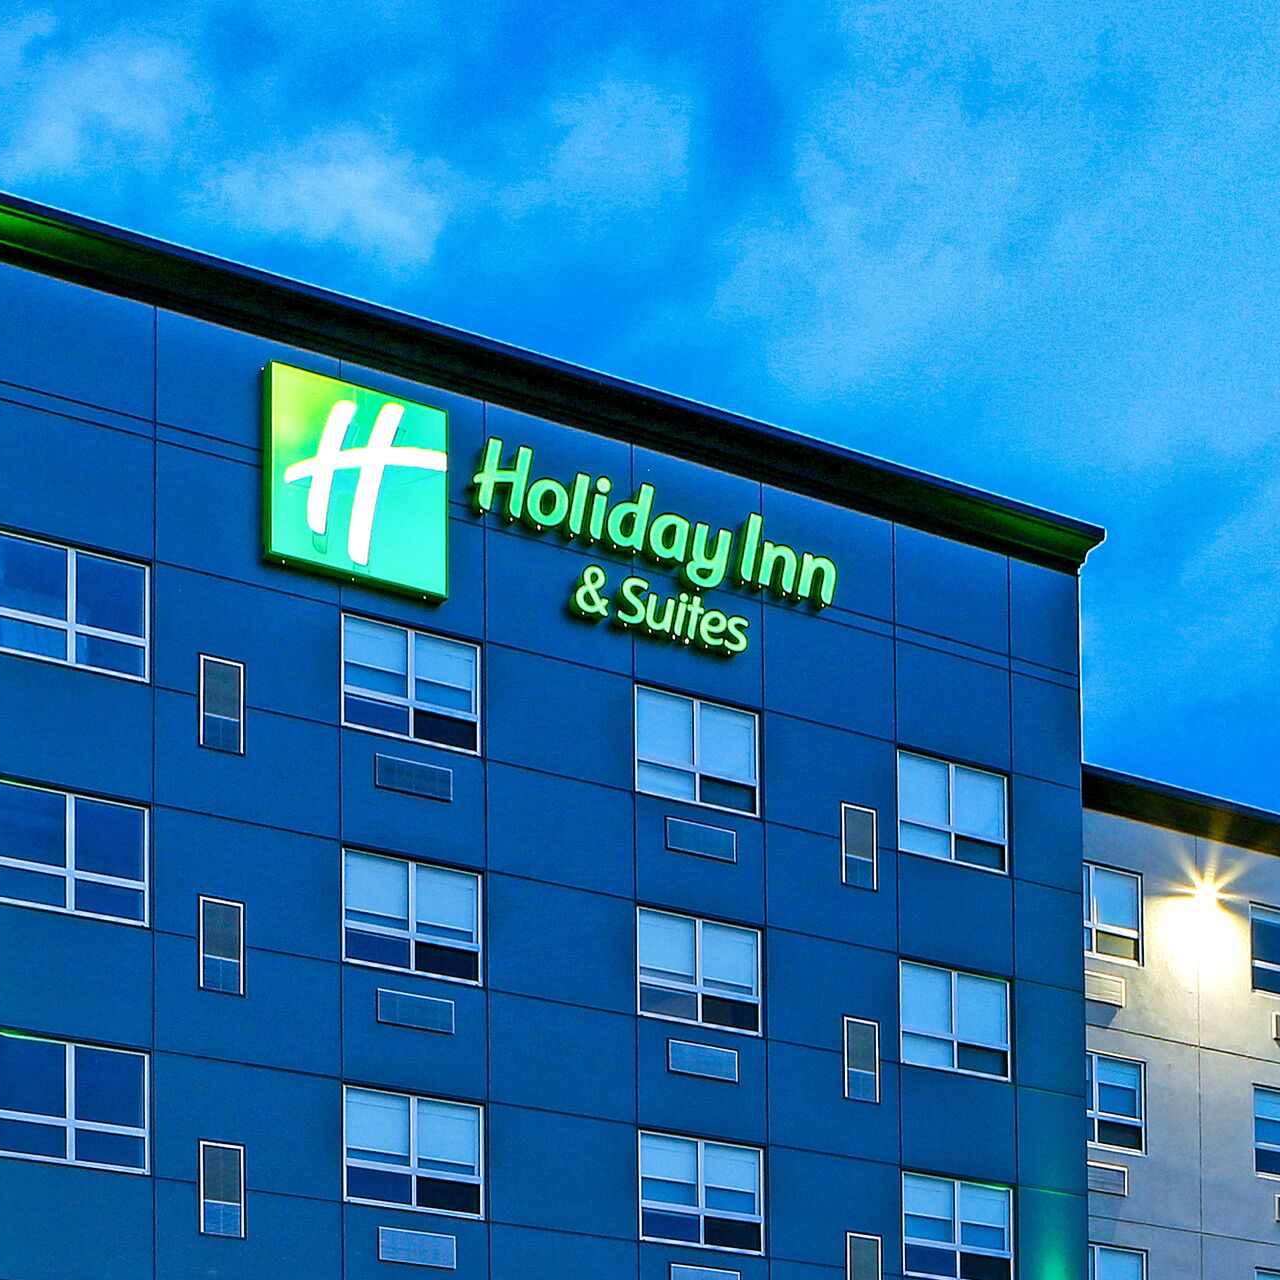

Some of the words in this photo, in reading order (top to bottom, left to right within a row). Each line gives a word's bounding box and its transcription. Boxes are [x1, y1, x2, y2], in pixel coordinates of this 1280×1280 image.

[473, 436, 732, 589] Holiday
[739, 512, 838, 608] Inn
[574, 564, 609, 616] &
[618, 577, 750, 654] Suites
